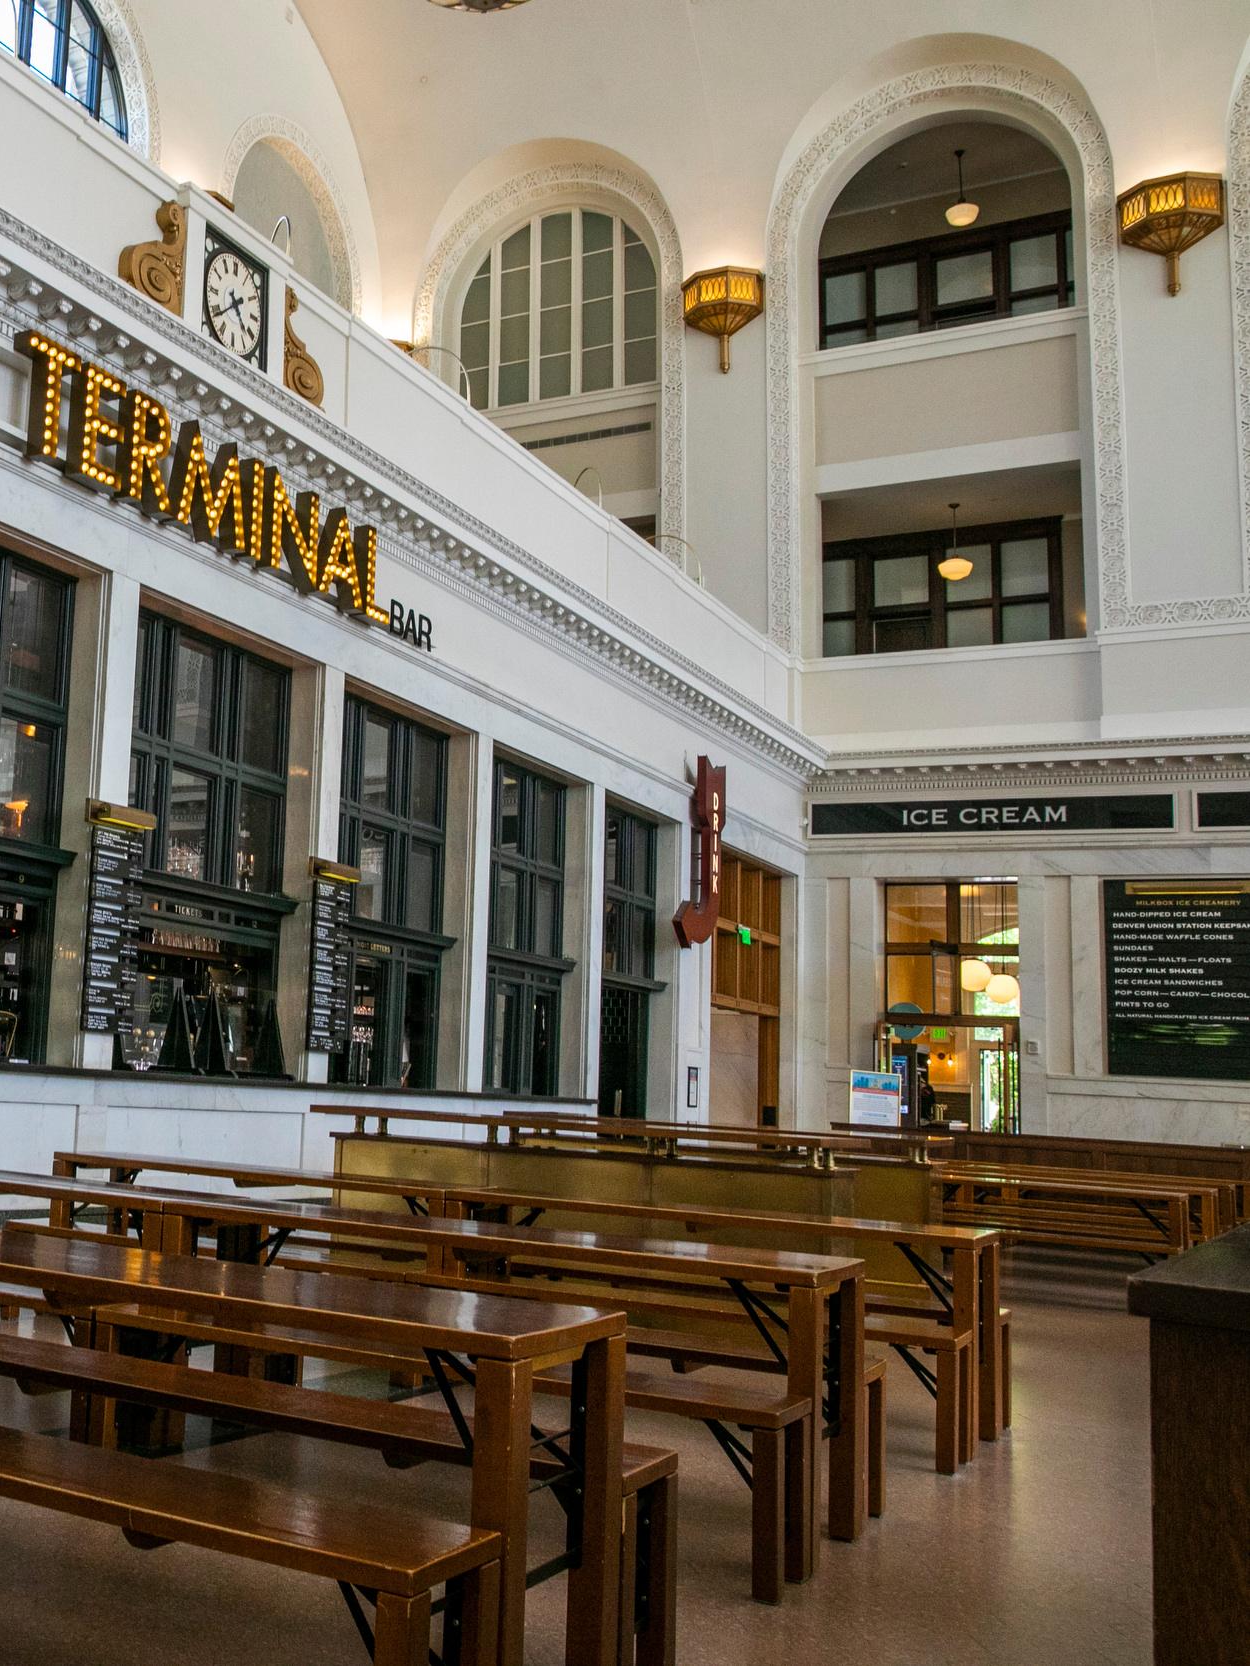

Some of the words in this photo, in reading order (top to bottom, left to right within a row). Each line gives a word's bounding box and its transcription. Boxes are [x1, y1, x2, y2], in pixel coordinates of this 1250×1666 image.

[15, 330, 390, 628] TERMINAL
[390, 598, 433, 653] BAR
[712, 792, 720, 894] DRINK
[901, 808, 949, 826] ICE
[958, 805, 1068, 825] CREAM
[174, 904, 204, 918] TICKETS
